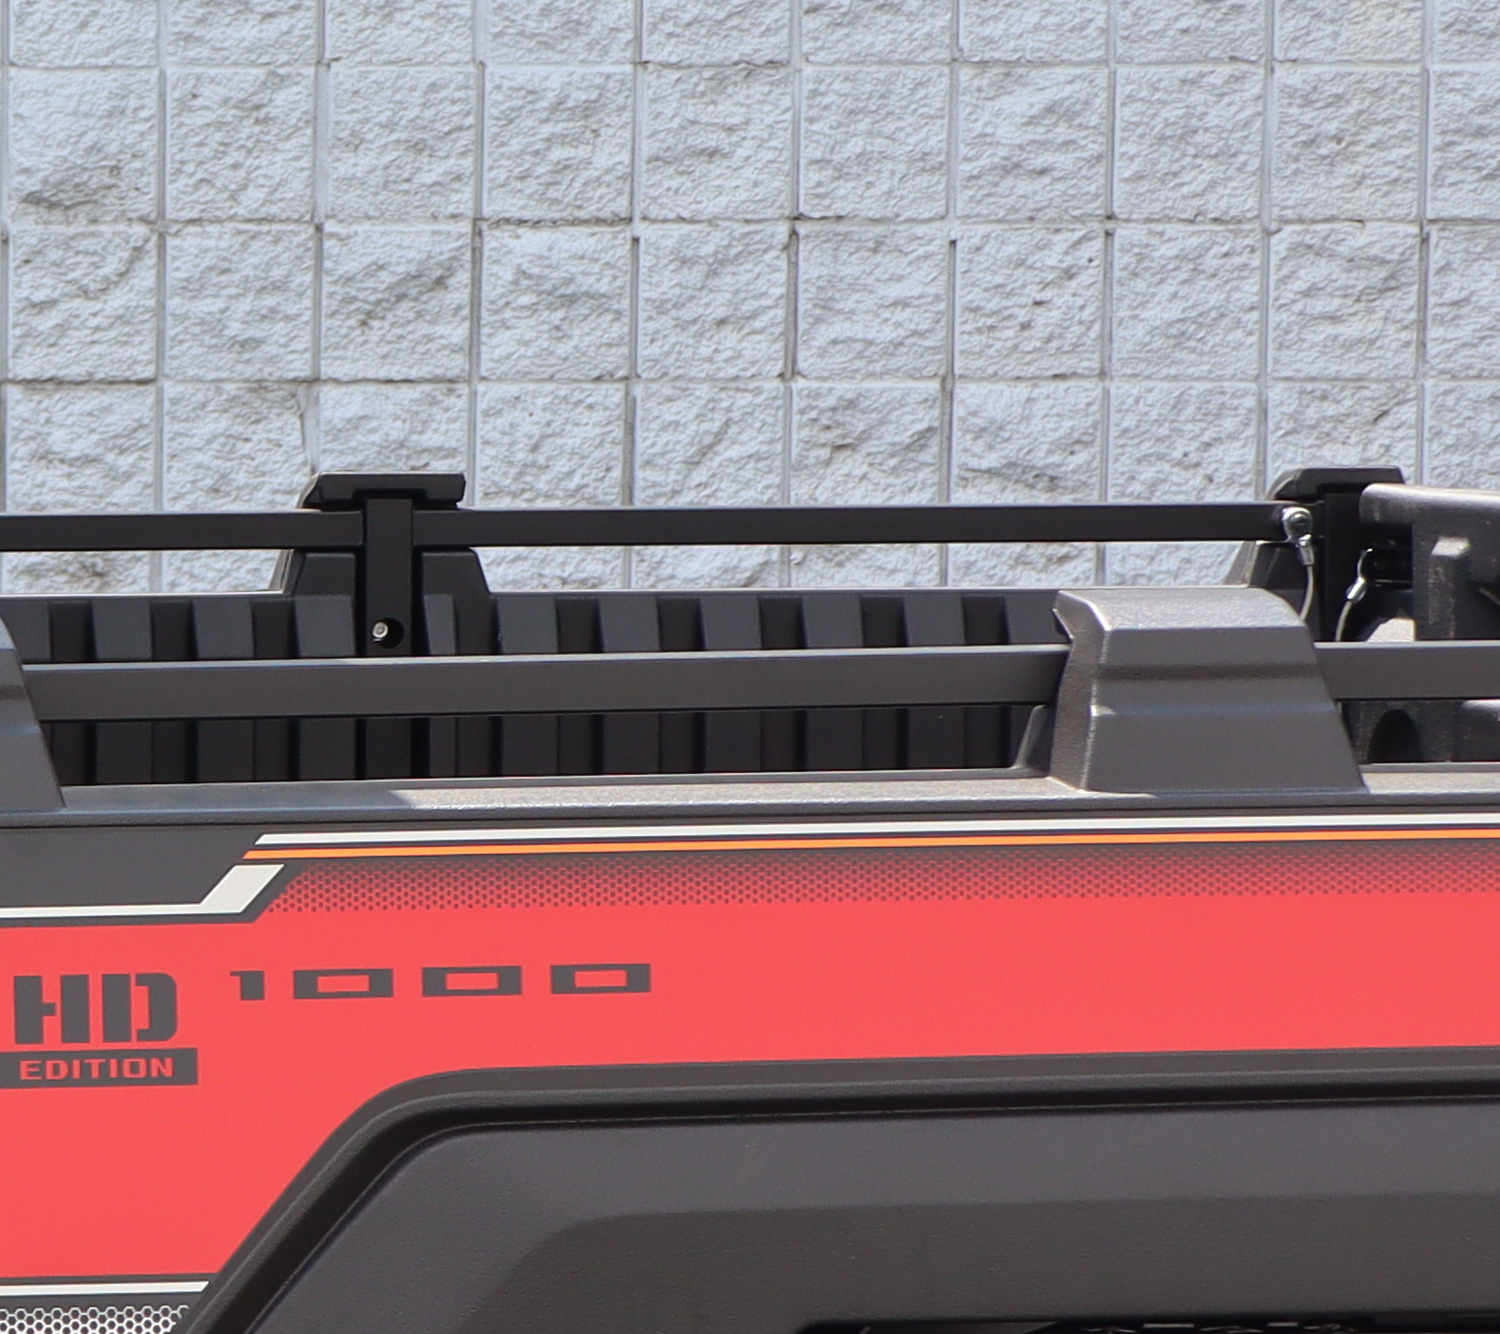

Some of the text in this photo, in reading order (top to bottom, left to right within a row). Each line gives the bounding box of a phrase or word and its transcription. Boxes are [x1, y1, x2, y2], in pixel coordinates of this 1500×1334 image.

[13, 963, 651, 1045] HD 1000
[18, 1056, 174, 1081] EDITION
